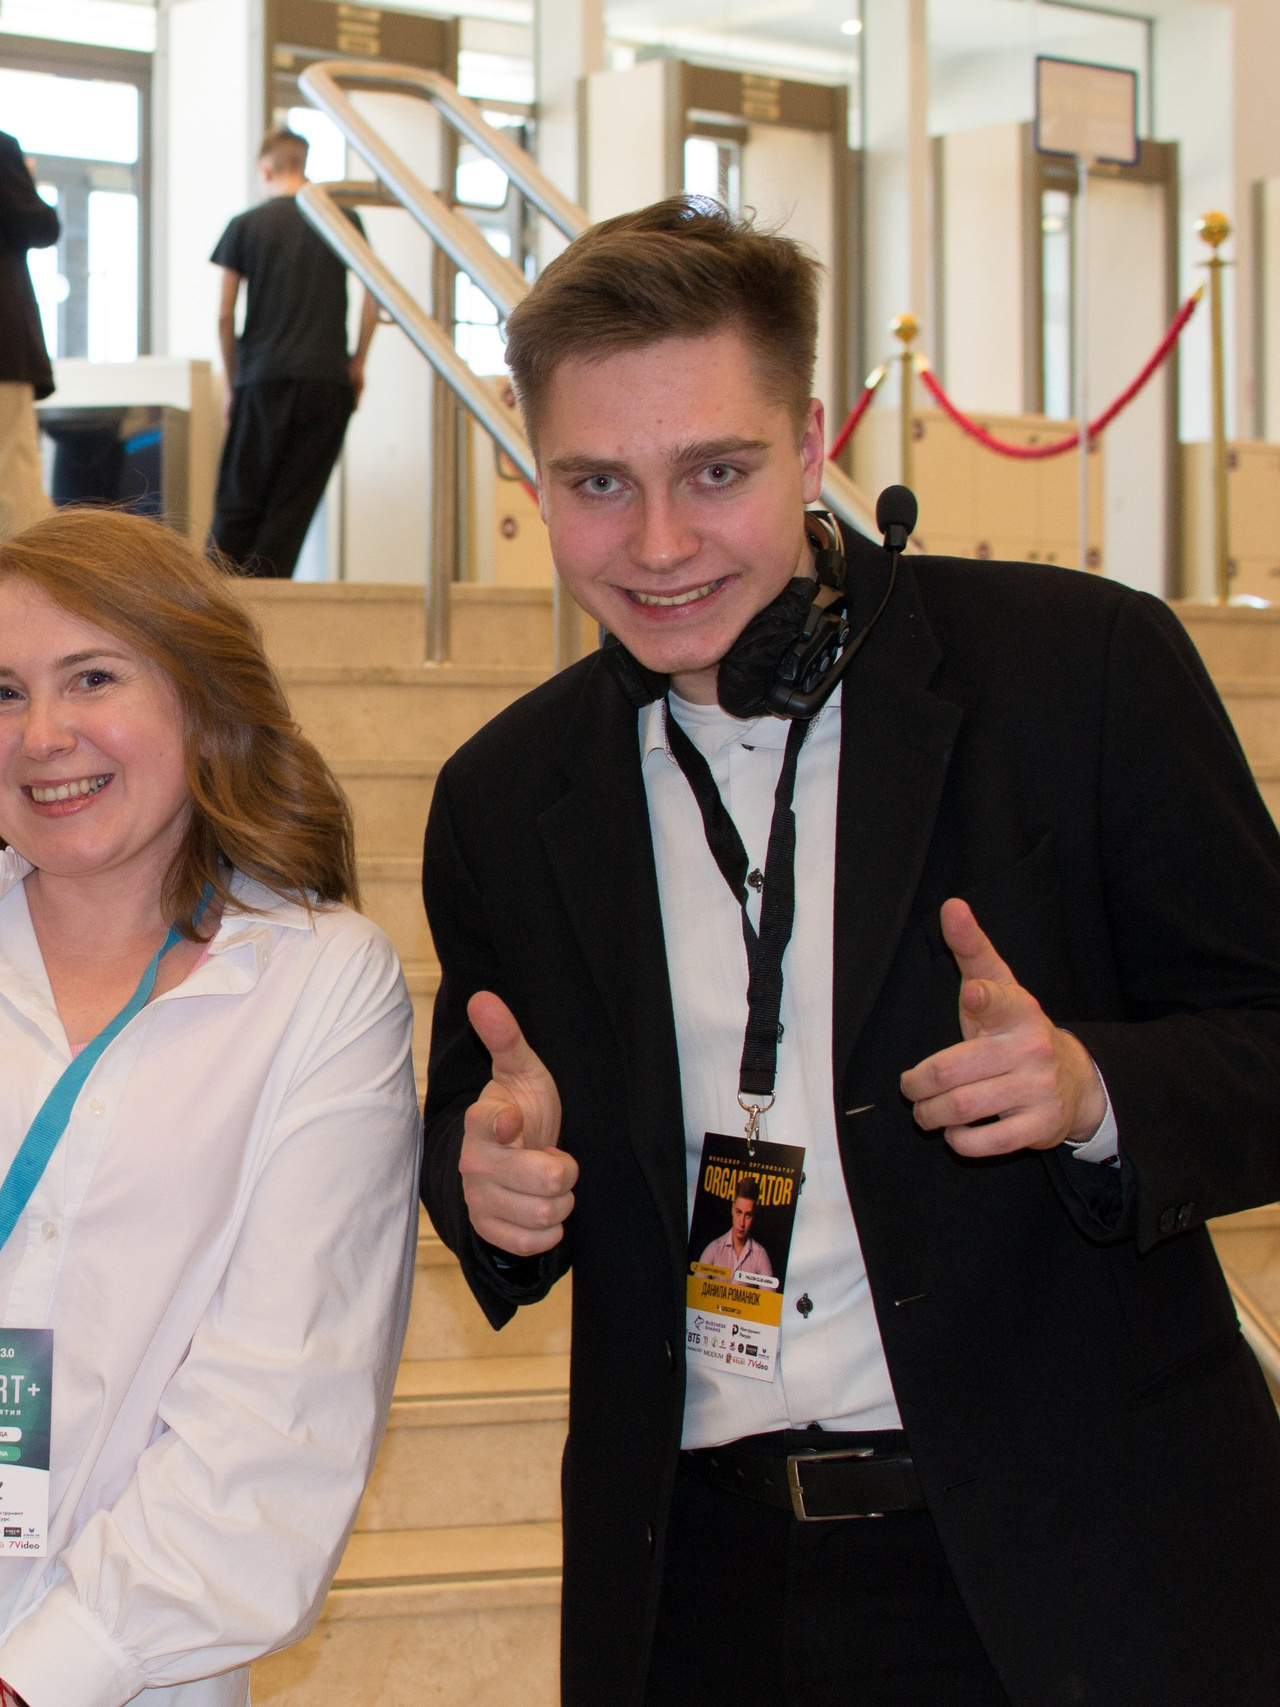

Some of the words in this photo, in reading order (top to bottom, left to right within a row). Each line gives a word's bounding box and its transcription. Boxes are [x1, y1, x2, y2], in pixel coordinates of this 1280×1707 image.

[704, 1165, 794, 1206] ORGAATOR
[687, 1331, 701, 1344] ВТБ
[0, 1348, 15, 1358] 3.0
[9, 1541, 40, 1550] 7Video
